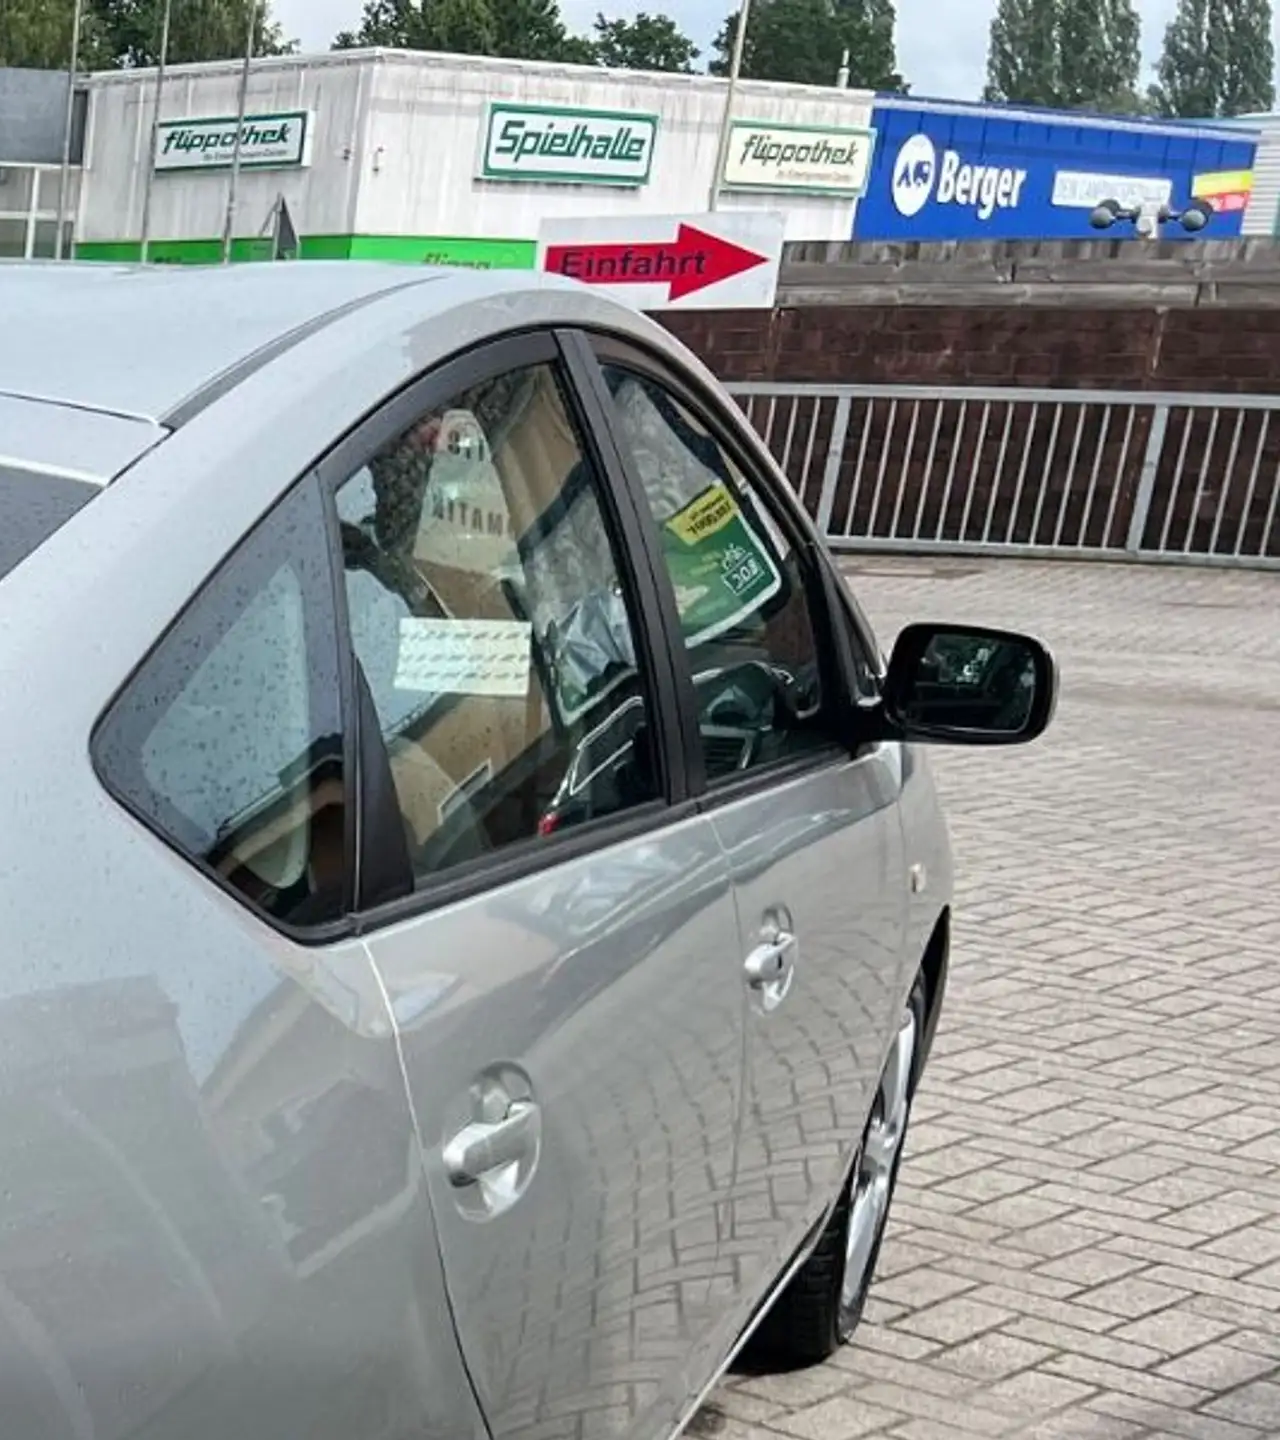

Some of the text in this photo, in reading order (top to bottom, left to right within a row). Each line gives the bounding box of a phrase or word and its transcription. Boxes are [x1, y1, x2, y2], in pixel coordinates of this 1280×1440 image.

[495, 120, 646, 163] Spielhalle
[740, 134, 858, 167] flippothek
[936, 150, 1028, 220] Berger
[561, 250, 707, 278] Einfahrt
